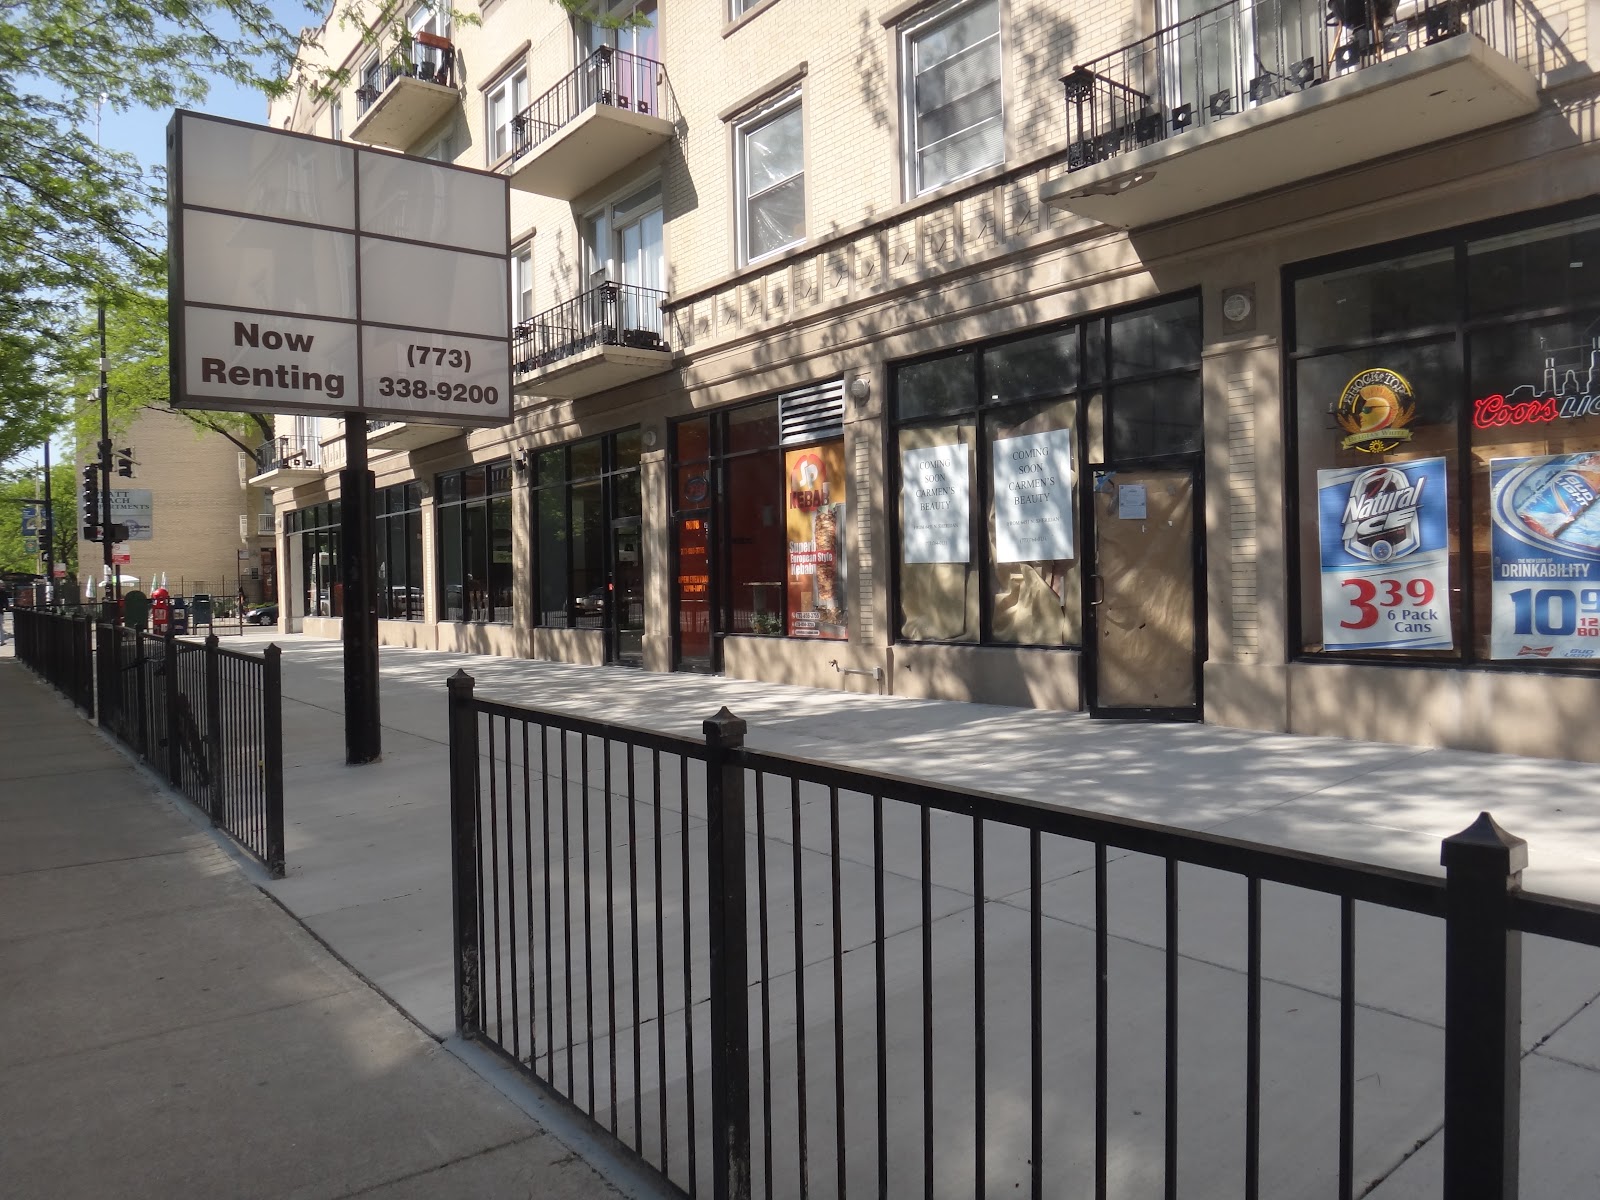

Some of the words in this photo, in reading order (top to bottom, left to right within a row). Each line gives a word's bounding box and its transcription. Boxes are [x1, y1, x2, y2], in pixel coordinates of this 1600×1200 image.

[234, 321, 315, 353] Now
[406, 344, 472, 373] (773)
[201, 357, 345, 399] Renting
[379, 376, 499, 405] 338-9200
[1475, 394, 1559, 429] Coors
[1012, 447, 1049, 461] COMING
[919, 458, 951, 470] COMING
[1018, 463, 1043, 475] SOON
[924, 473, 946, 483] SOON
[1008, 477, 1055, 491] CARMEN'S
[790, 489, 830, 509] KEBAB
[915, 486, 956, 498] CARMEN'S
[1014, 492, 1051, 506] BEAUTY
[920, 500, 951, 511] BEAUTY
[1342, 477, 1424, 524] Natural
[1342, 508, 1417, 541] ICE
[789, 540, 817, 553] Superb
[790, 553, 817, 564] European
[817, 552, 833, 563] Style
[1501, 563, 1590, 578] DRINKABILITY
[1387, 609, 1396, 620] 6
[1402, 609, 1438, 620] Pack
[1394, 621, 1432, 633] Cans
[1580, 617, 1598, 627] 12
